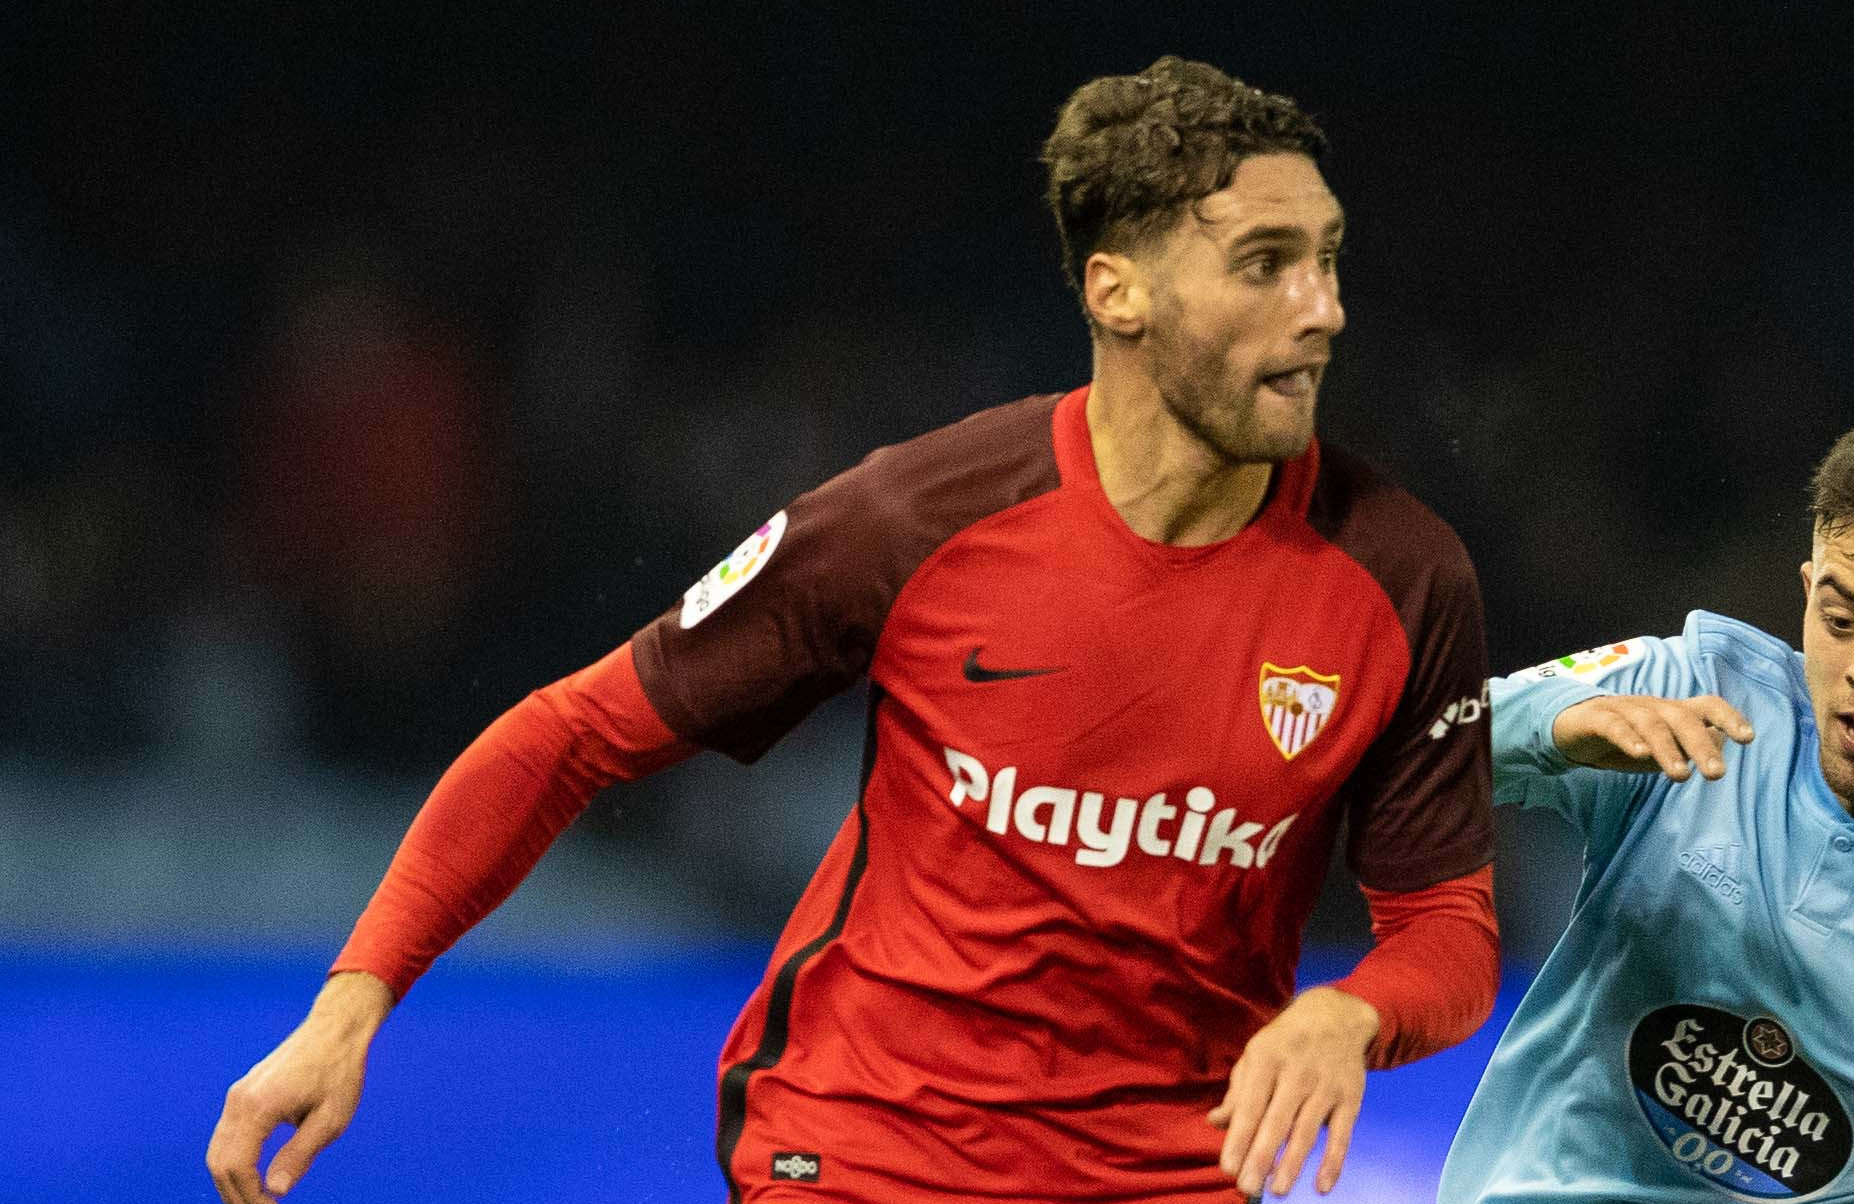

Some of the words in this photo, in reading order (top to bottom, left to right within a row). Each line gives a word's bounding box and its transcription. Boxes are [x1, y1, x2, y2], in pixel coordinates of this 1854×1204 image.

[944, 747, 1299, 869] Playtika
[1679, 851, 1744, 905] adidas
[1655, 1062, 1800, 1178] Galicia
[1660, 1018, 1831, 1142] Estrella
